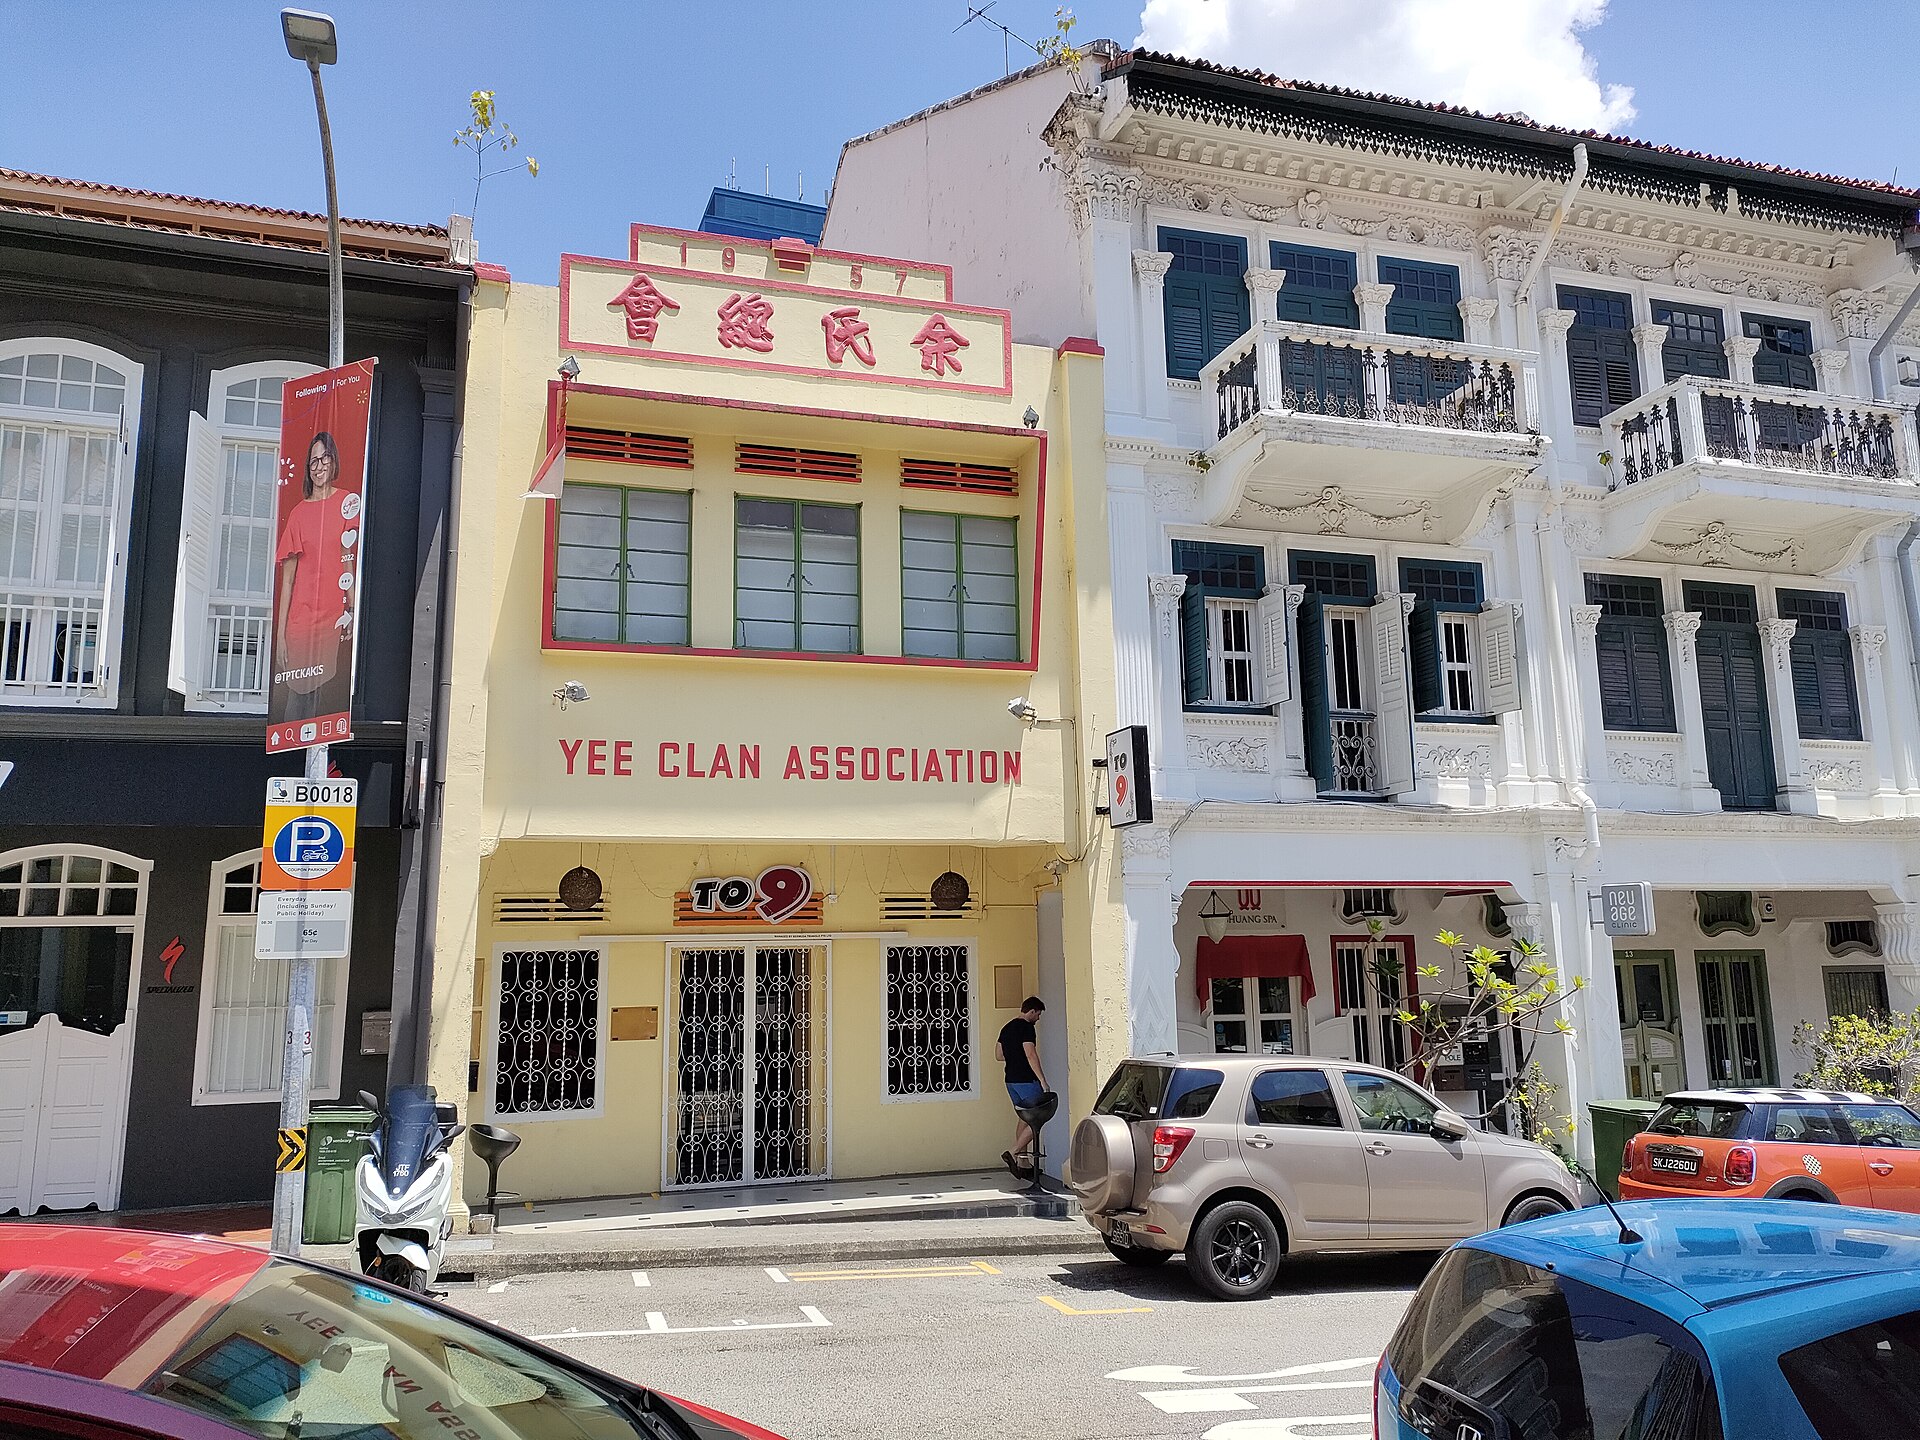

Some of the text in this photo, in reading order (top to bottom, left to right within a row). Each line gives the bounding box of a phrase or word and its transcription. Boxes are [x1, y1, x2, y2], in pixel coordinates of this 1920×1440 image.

[295, 376, 360, 398] Following For You
[340, 553, 355, 563] 2022
[274, 664, 324, 684] @TPTCKAKIS
[558, 739, 1022, 787] YEE CLAN ASSOCIATION
[1113, 752, 1128, 773] TO
[295, 785, 353, 803] B0018
[1115, 774, 1129, 807] 9
[289, 821, 331, 862] P
[1609, 890, 1635, 906] neu
[1227, 915, 1278, 924] HUANG SPA
[287, 1030, 293, 1045] 3
[303, 1030, 311, 1045] 3
[395, 1163, 410, 1171] JTF
[1652, 1157, 1697, 1172] SKJ2260U
